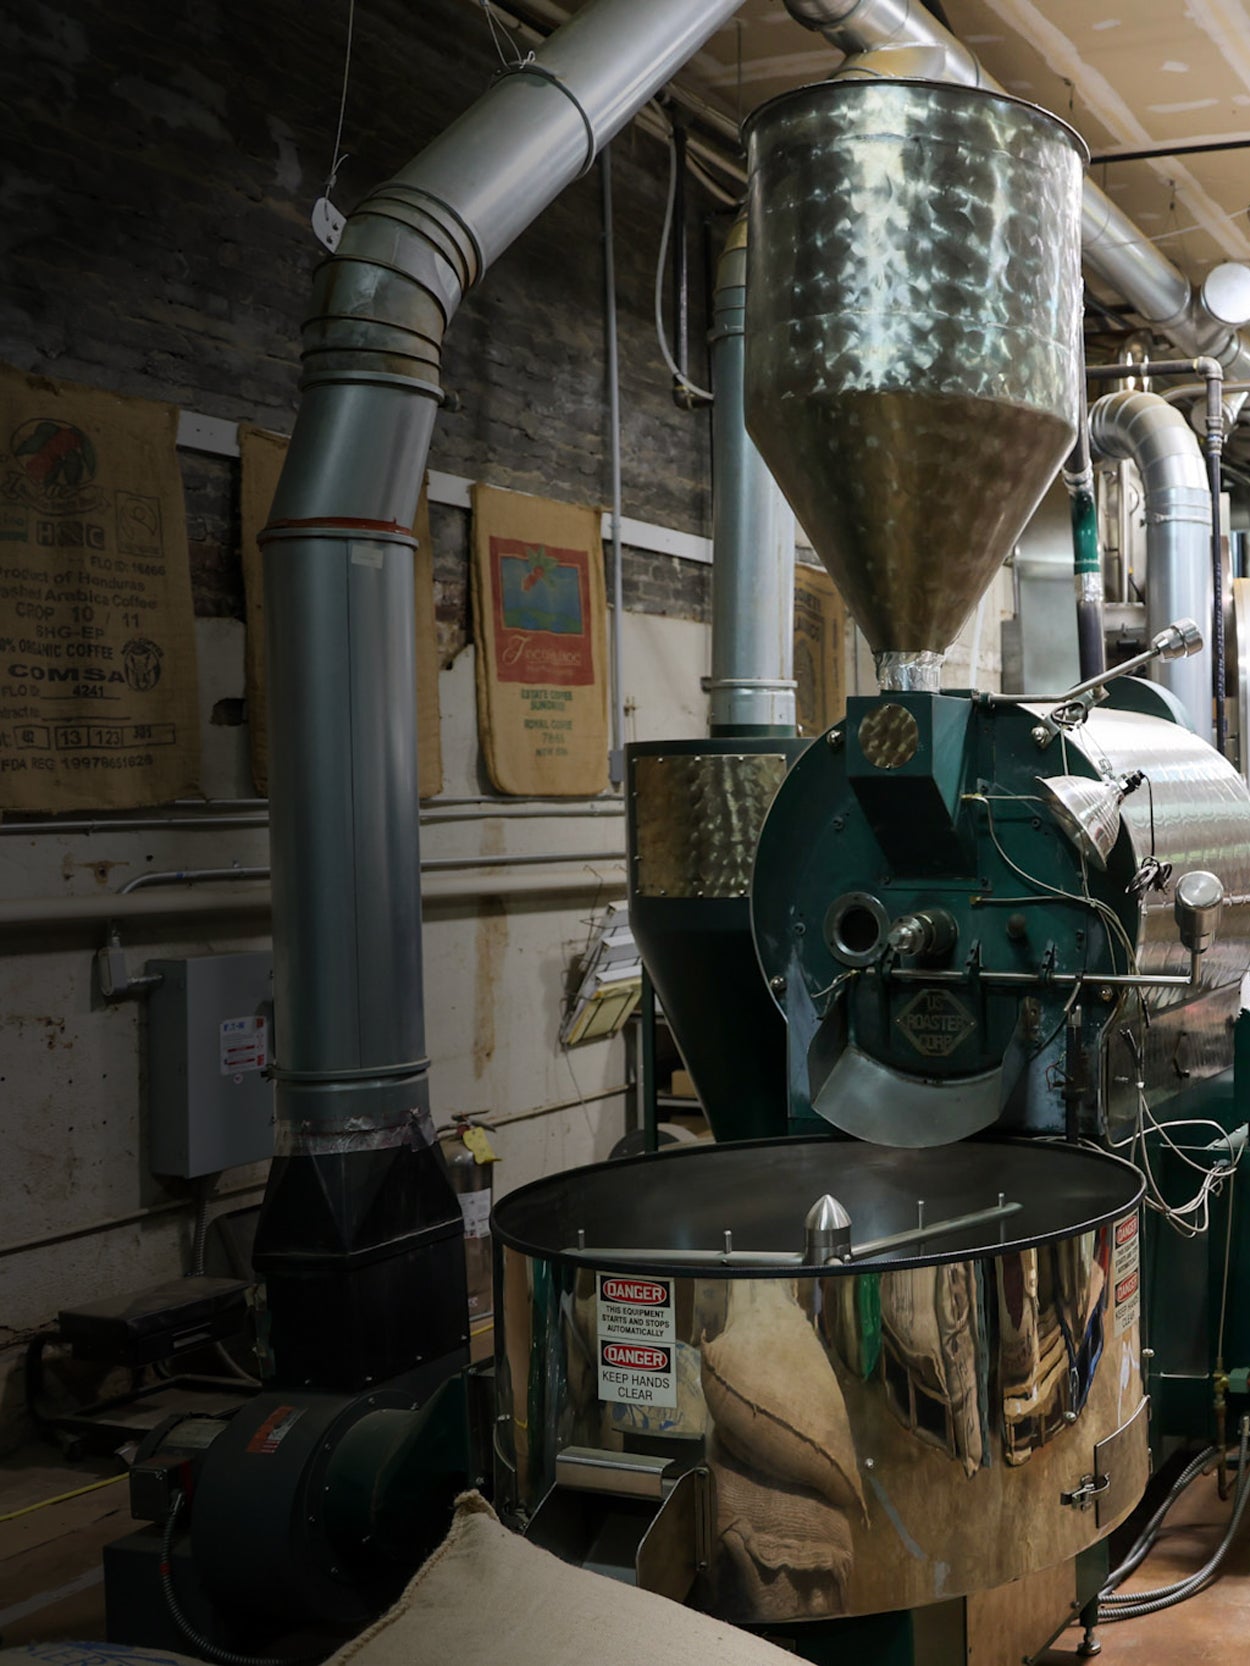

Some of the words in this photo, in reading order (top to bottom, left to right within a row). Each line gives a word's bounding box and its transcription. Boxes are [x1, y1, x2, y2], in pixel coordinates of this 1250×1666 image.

[90, 555, 112, 571] FLO
[0, 566, 48, 583] roduct
[54, 570, 73, 585] of
[78, 571, 146, 592] Honduras
[0, 584, 41, 600] ashed
[44, 588, 109, 607] Arabica
[112, 594, 158, 610] Coffee
[15, 602, 55, 621] CROP
[71, 606, 94, 623] 10
[122, 612, 140, 628] 11
[66, 643, 113, 660] COFFEE
[8, 663, 126, 684] COMSA
[1, 684, 28, 697] FLO
[72, 684, 104, 698] 4241
[60, 730, 82, 745] 13
[95, 730, 121, 745] 123
[1, 758, 28, 772] FDA
[927, 994, 944, 1011] US
[919, 1033, 953, 1050] CORP
[607, 1282, 663, 1301] DANGER
[606, 1305, 621, 1314] THIS
[623, 1307, 665, 1318] EQUIPMENT
[602, 1314, 627, 1324] STARTS
[629, 1318, 644, 1326] AND
[645, 1319, 670, 1328] STOPS
[608, 1324, 664, 1337] AUTOMATICALLY
[608, 1347, 663, 1368] DANGER
[602, 1371, 628, 1383] KEEP
[632, 1375, 670, 1389] HANDS
[618, 1387, 653, 1400] CLEAR
